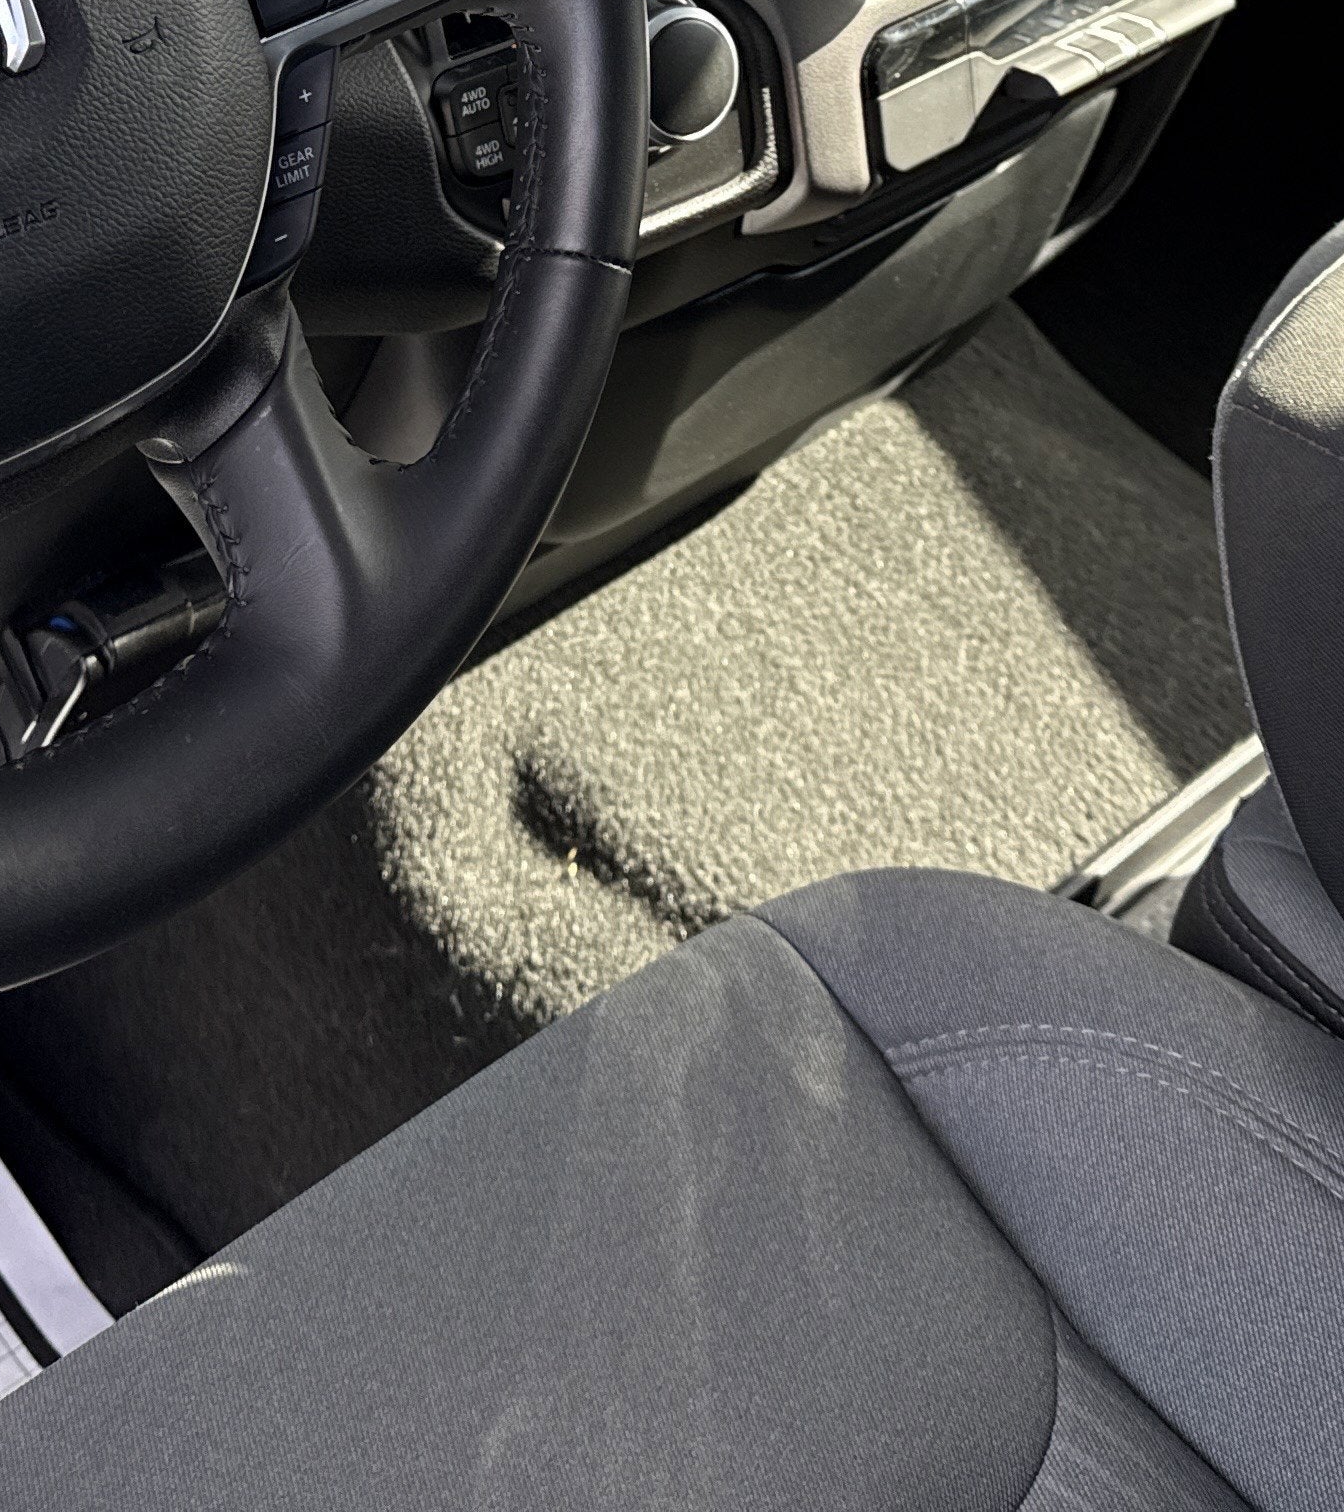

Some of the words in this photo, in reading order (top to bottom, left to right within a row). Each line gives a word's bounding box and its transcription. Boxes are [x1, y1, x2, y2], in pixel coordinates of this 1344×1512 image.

[461, 86, 487, 103] 4WD
[462, 97, 491, 118] AUTO
[277, 146, 315, 169] GEAR
[475, 140, 500, 156] 4WD
[476, 151, 504, 170] HIGH
[275, 164, 311, 187] LIMIT
